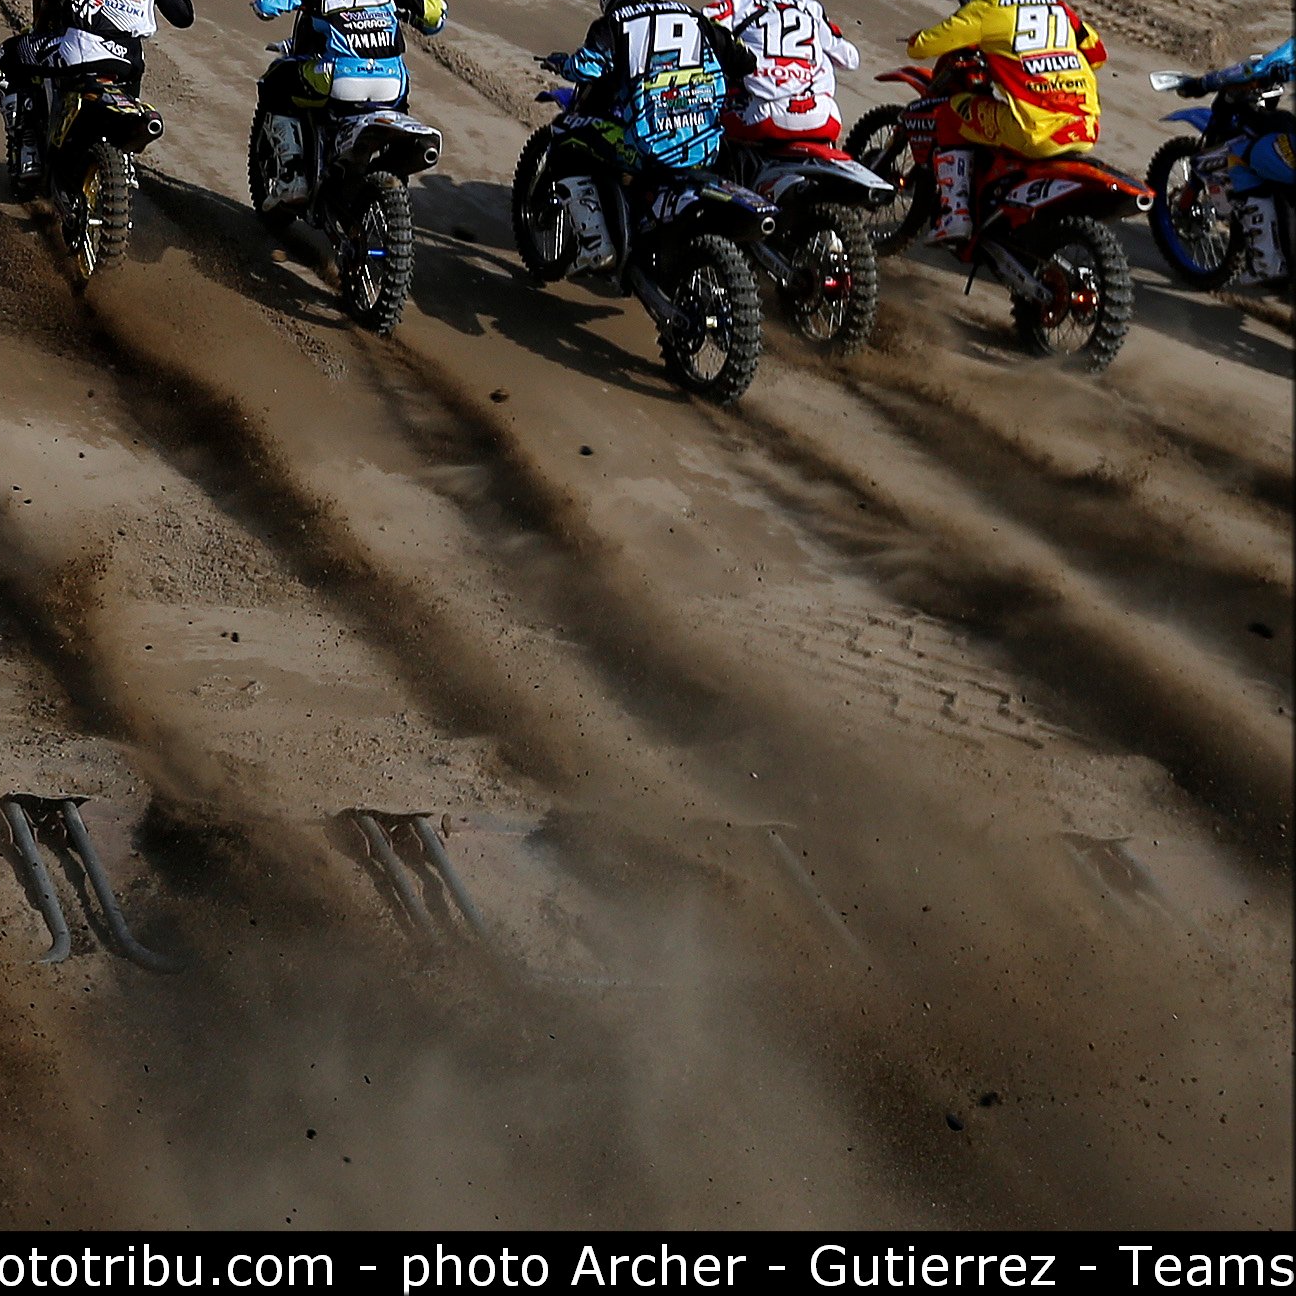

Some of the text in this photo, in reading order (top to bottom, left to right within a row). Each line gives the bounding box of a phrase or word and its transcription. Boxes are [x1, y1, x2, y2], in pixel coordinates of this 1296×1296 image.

[104, 0, 145, 18] SUZUKI
[759, 8, 814, 59] 12
[1014, 4, 1069, 52] 91
[623, 13, 702, 78] 19
[1025, 55, 1081, 75] WILVO
[657, 112, 706, 132] YAMAHA
[905, 118, 935, 131] WILV
